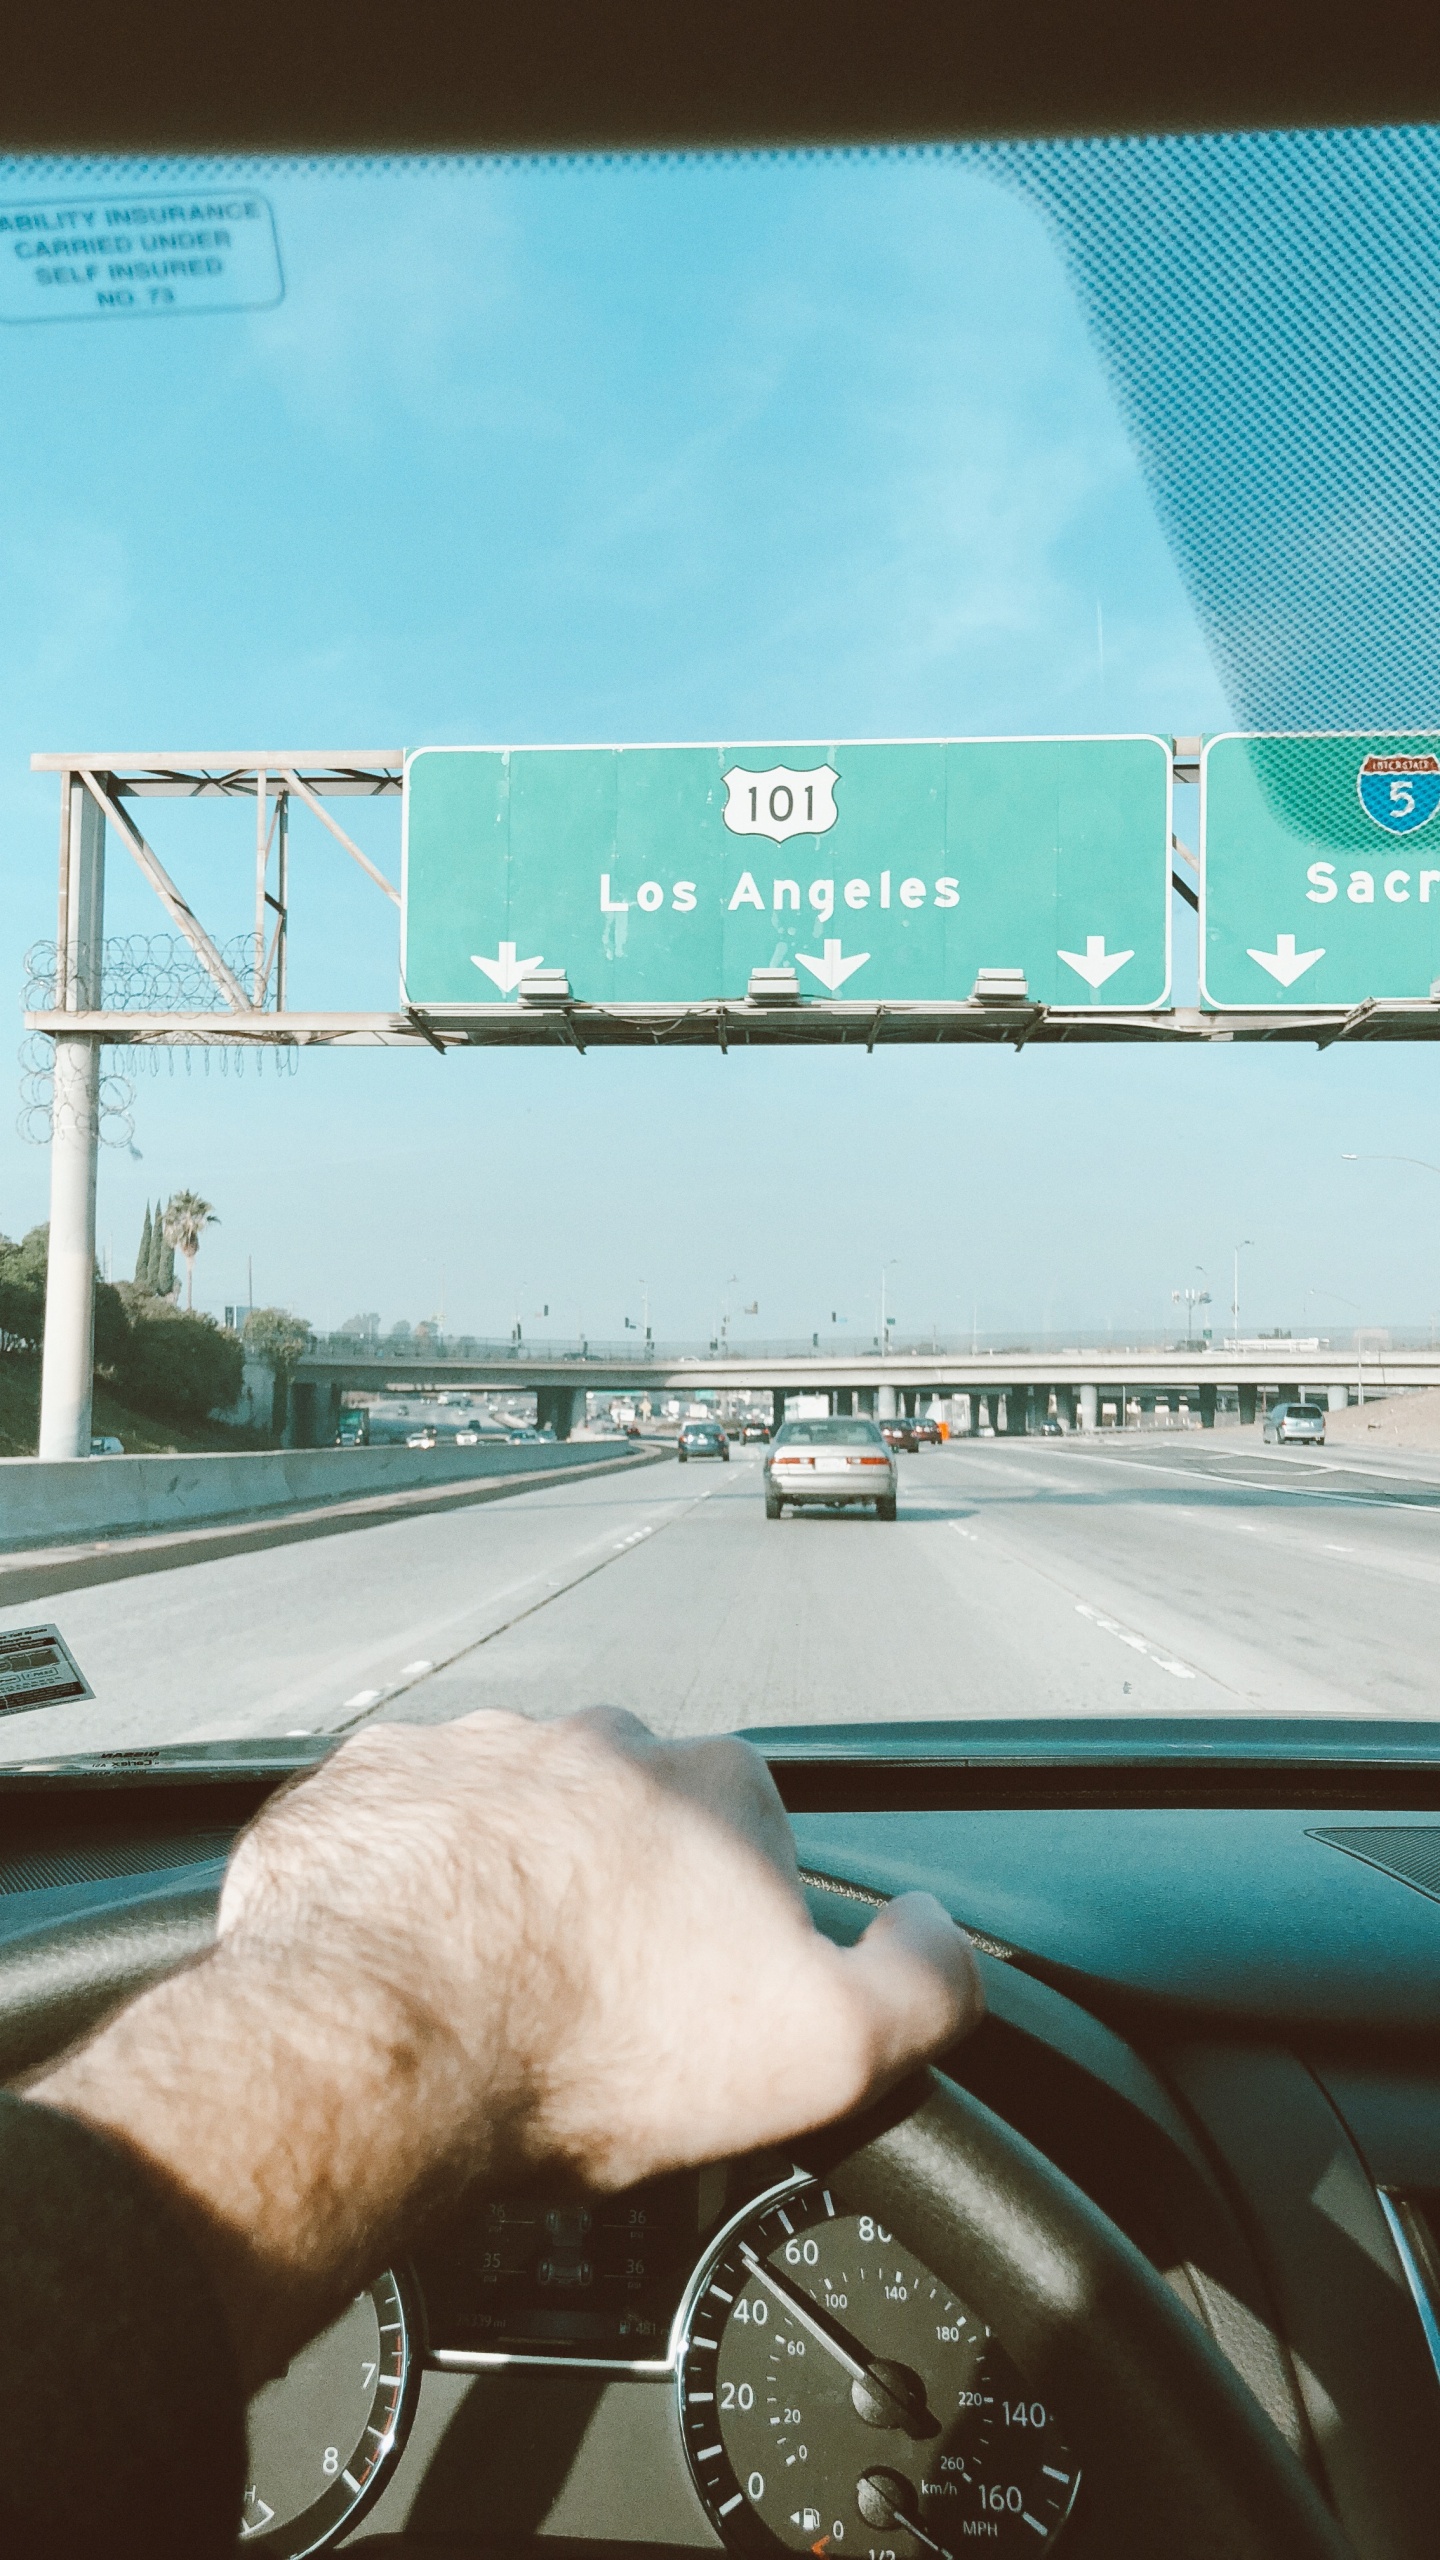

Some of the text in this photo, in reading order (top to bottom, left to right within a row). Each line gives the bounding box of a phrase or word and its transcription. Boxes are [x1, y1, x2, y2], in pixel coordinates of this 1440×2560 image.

[105, 202, 259, 226] INSURANCE
[14, 228, 231, 259] CARRIED UNDER
[35, 256, 222, 285] SELF INSURED
[748, 785, 814, 822] 101
[1389, 781, 1416, 818] 5
[1305, 861, 1440, 903] Sacr
[600, 870, 960, 922] Los Angeles
[628, 2209, 648, 2225] 36
[483, 2252, 502, 2269] 35
[785, 2239, 819, 2266] 60
[625, 2258, 645, 2275] 36
[825, 2294, 848, 2309] 100
[884, 2285, 908, 2301] 140
[733, 2299, 769, 2326] 40
[936, 2326, 959, 2342] 180
[787, 2341, 805, 2357] 60
[361, 2362, 377, 2389] 7
[721, 2382, 754, 2410] 20
[958, 2391, 983, 2407] 220
[783, 2408, 801, 2424] 20
[1002, 2402, 1045, 2428] 140
[322, 2446, 338, 2473] 8
[798, 2445, 808, 2460] 0
[940, 2456, 965, 2471] 260
[748, 2471, 765, 2500] 0
[921, 2480, 958, 2497] km/h
[978, 2486, 1023, 2513] 160
[832, 2521, 845, 2540] 0
[962, 2521, 999, 2537] MPH
